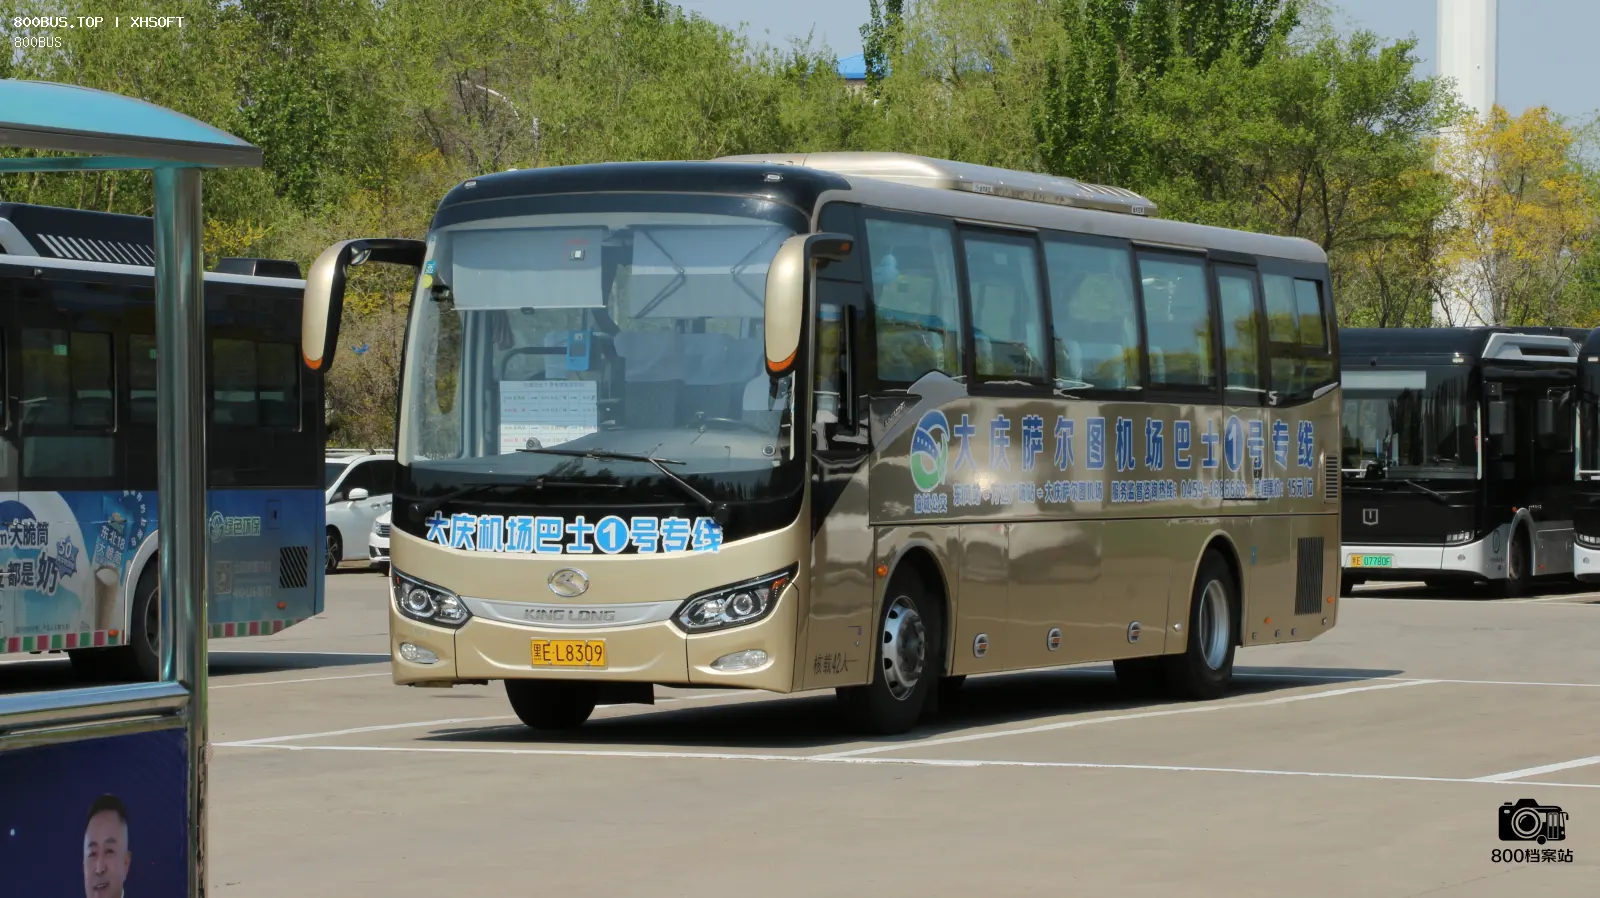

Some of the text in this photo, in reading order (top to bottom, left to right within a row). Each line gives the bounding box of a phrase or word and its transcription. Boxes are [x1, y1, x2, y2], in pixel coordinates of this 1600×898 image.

[1044, 480, 1103, 504] 大庆萨尔图机场
[224, 516, 261, 537] 绿色环保
[0, 551, 58, 594] 都是奶
[524, 609, 615, 621] KING LONG
